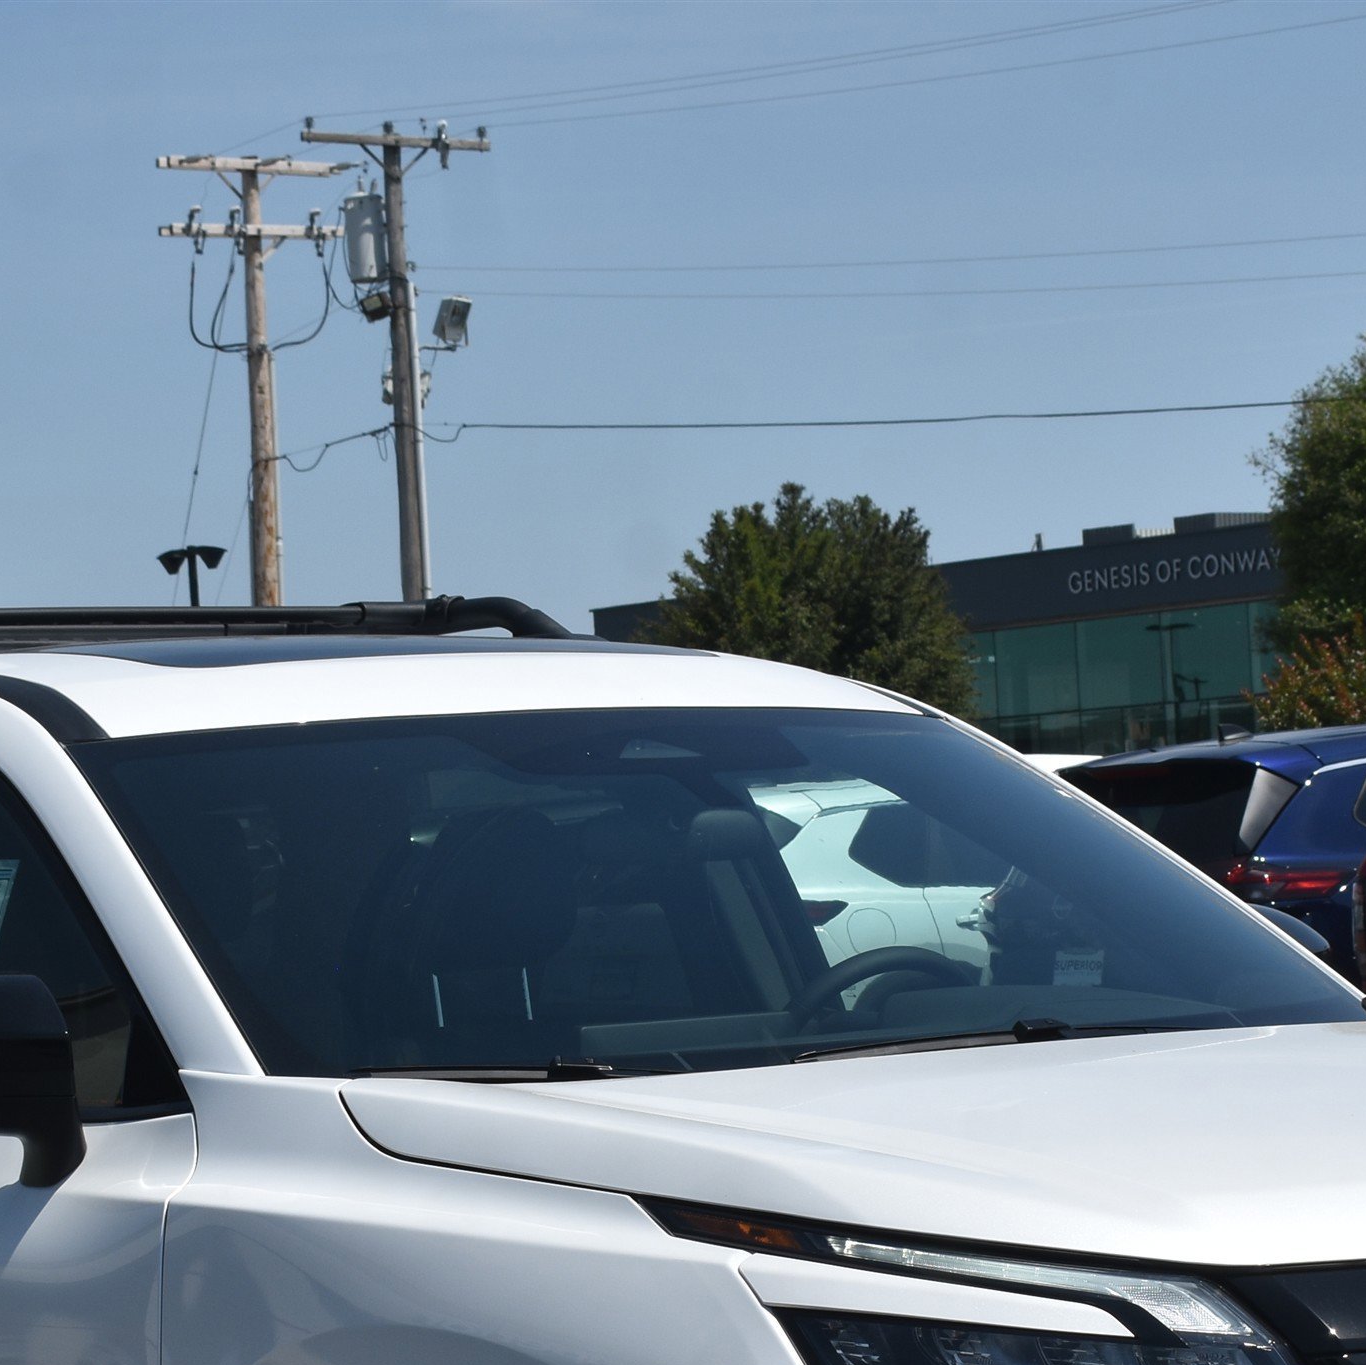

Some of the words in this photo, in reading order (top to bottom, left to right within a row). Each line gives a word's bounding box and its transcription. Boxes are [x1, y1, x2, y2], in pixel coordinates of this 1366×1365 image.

[1068, 564, 1150, 594] GENESIS
[1156, 559, 1181, 583] OF
[1188, 547, 1281, 580] CONWAY
